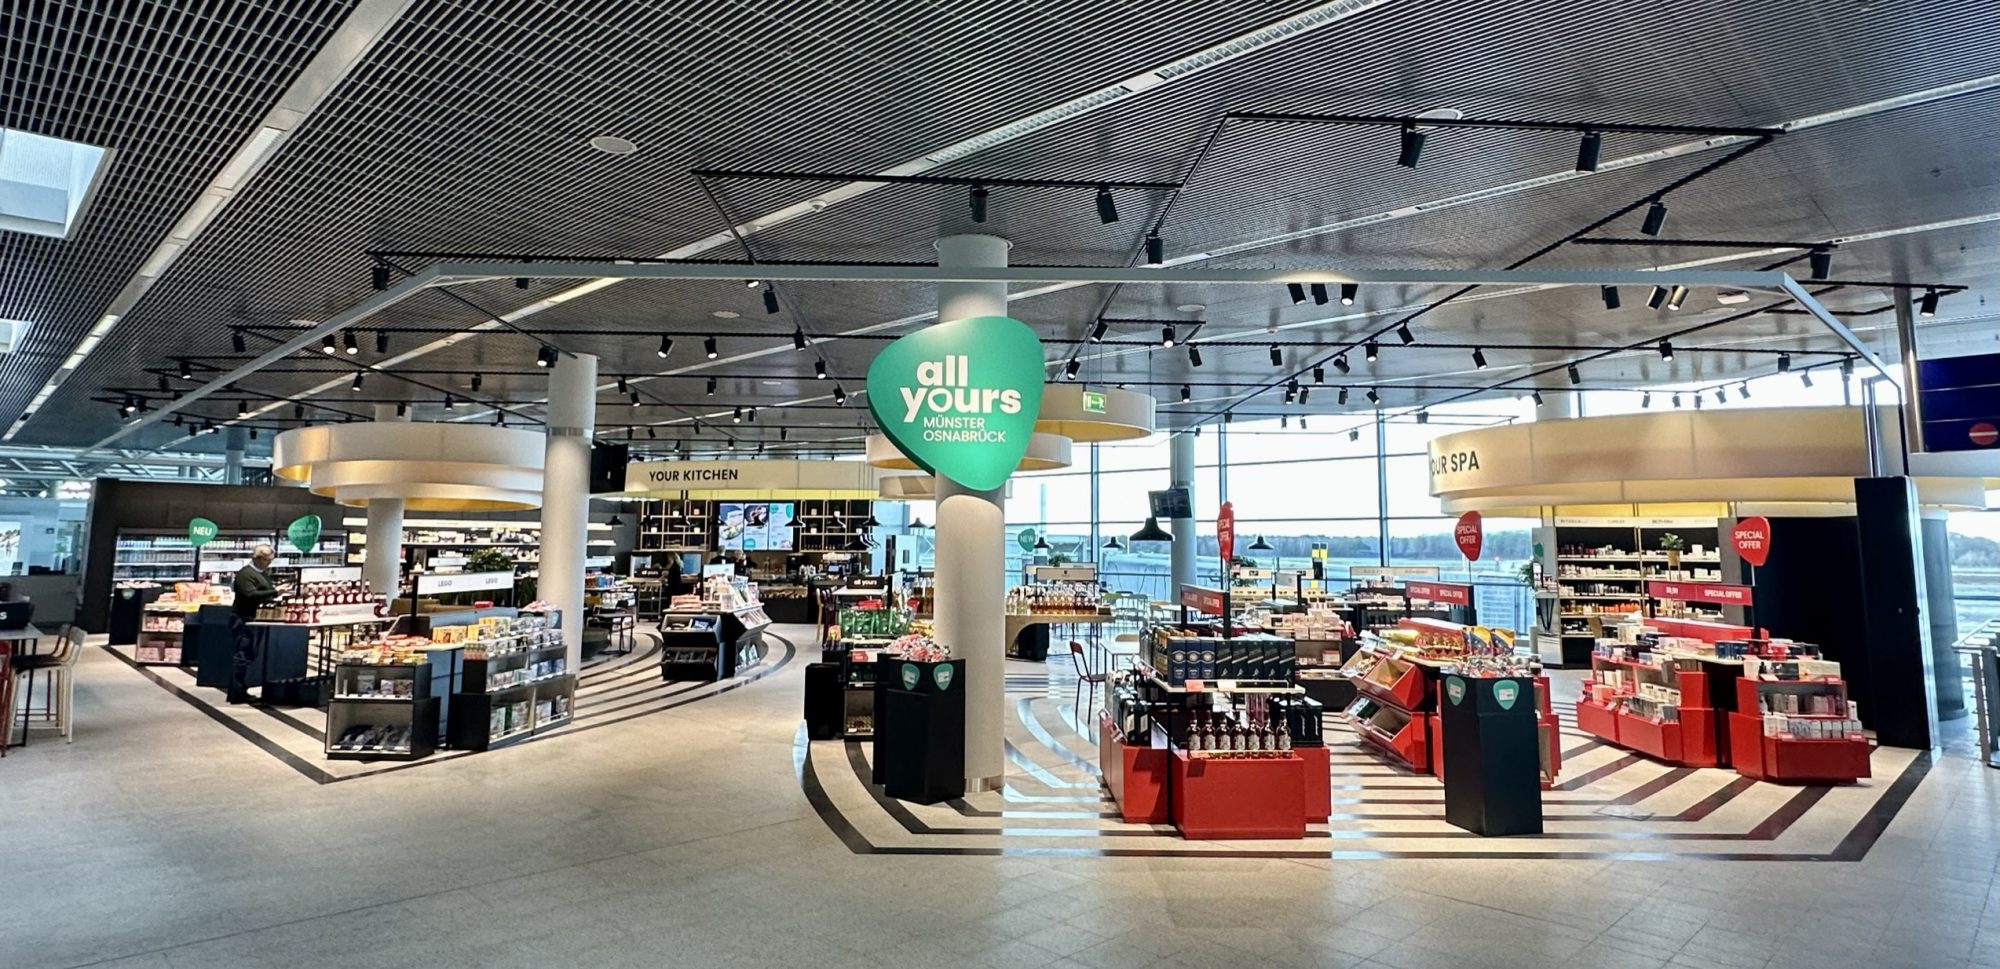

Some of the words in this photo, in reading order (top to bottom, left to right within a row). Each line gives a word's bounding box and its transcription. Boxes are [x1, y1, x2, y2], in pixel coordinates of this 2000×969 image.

[917, 355, 968, 387] all
[899, 387, 1021, 423] yours
[923, 415, 984, 429] MÜNSTER
[923, 427, 1006, 442] OSNABRÜCK
[1431, 456, 1447, 476] OUR
[1451, 450, 1479, 472] SPA
[649, 471, 680, 482] YOUR
[683, 469, 738, 481] KITCHEN
[193, 526, 212, 536] NEU
[1457, 525, 1478, 535] SPECIAL
[1735, 530, 1764, 540] SPECIAL
[1020, 535, 1034, 543] NEW
[1459, 535, 1476, 544] OFFER
[1738, 540, 1761, 549] OFFER
[1704, 589, 1725, 598] SPECIAL
[1725, 590, 1742, 599] OFFER
